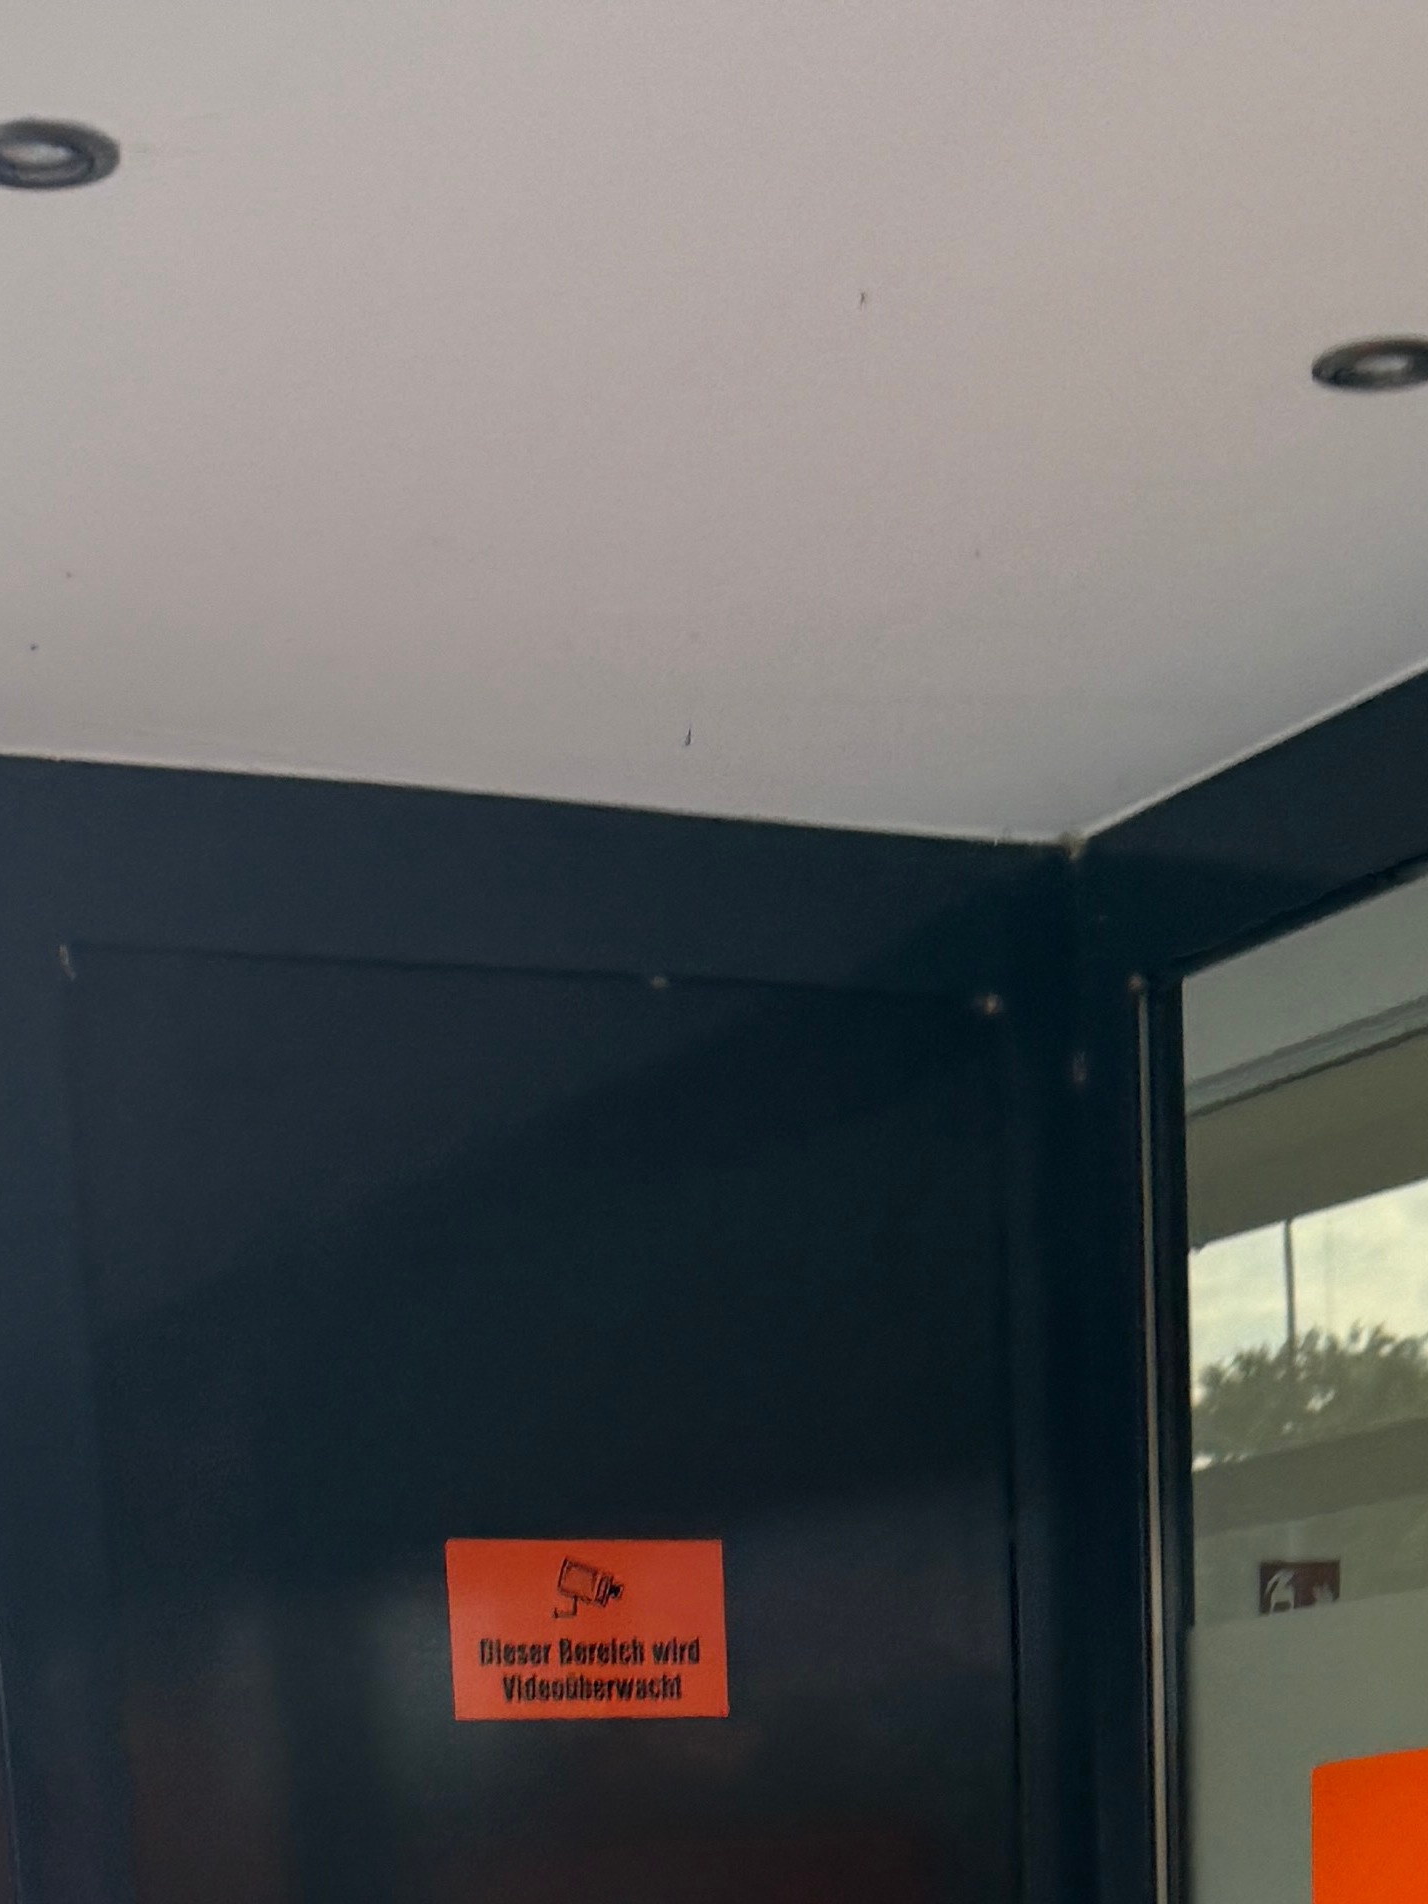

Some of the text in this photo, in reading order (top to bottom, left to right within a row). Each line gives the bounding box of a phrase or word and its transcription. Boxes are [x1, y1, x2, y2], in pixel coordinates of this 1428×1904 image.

[479, 1636, 700, 1666] Dieser Bereich wird
